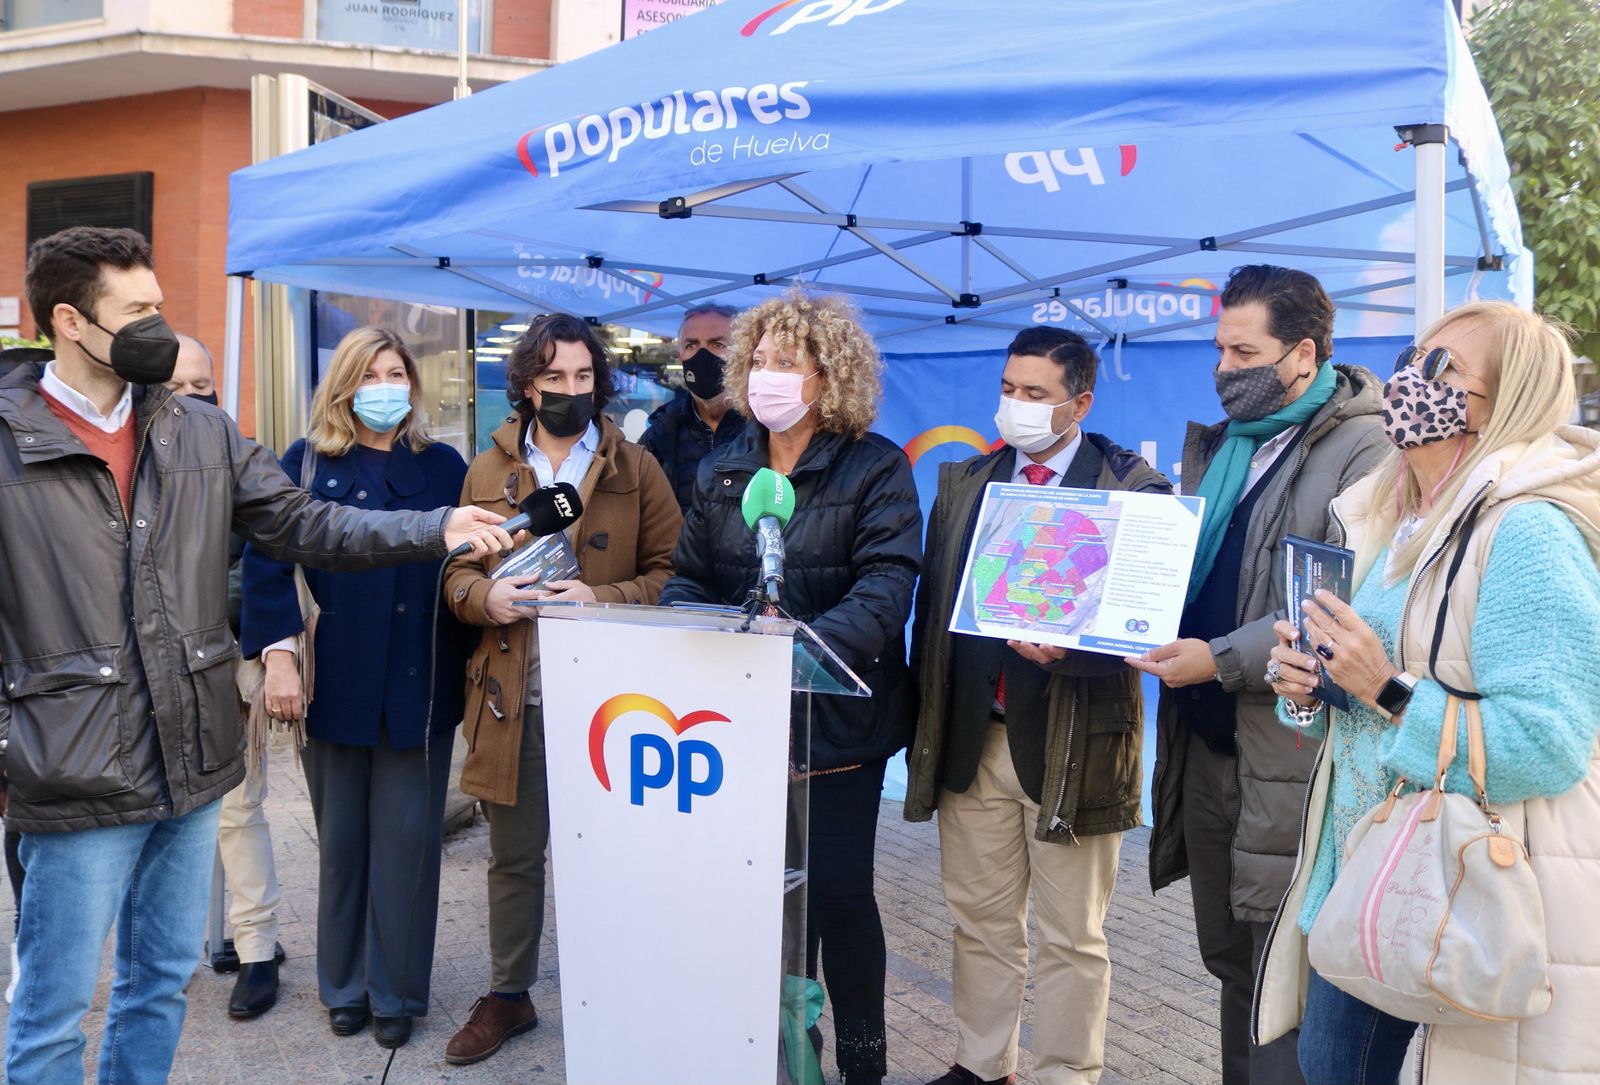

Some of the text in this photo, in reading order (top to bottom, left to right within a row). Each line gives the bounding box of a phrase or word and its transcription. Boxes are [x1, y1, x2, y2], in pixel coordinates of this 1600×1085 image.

[345, 3, 378, 14] JUAN
[769, 0, 906, 36] pp
[544, 80, 811, 178] populares
[689, 131, 831, 167] de Huelva
[554, 493, 574, 517] HTV
[630, 733, 724, 814] pp
